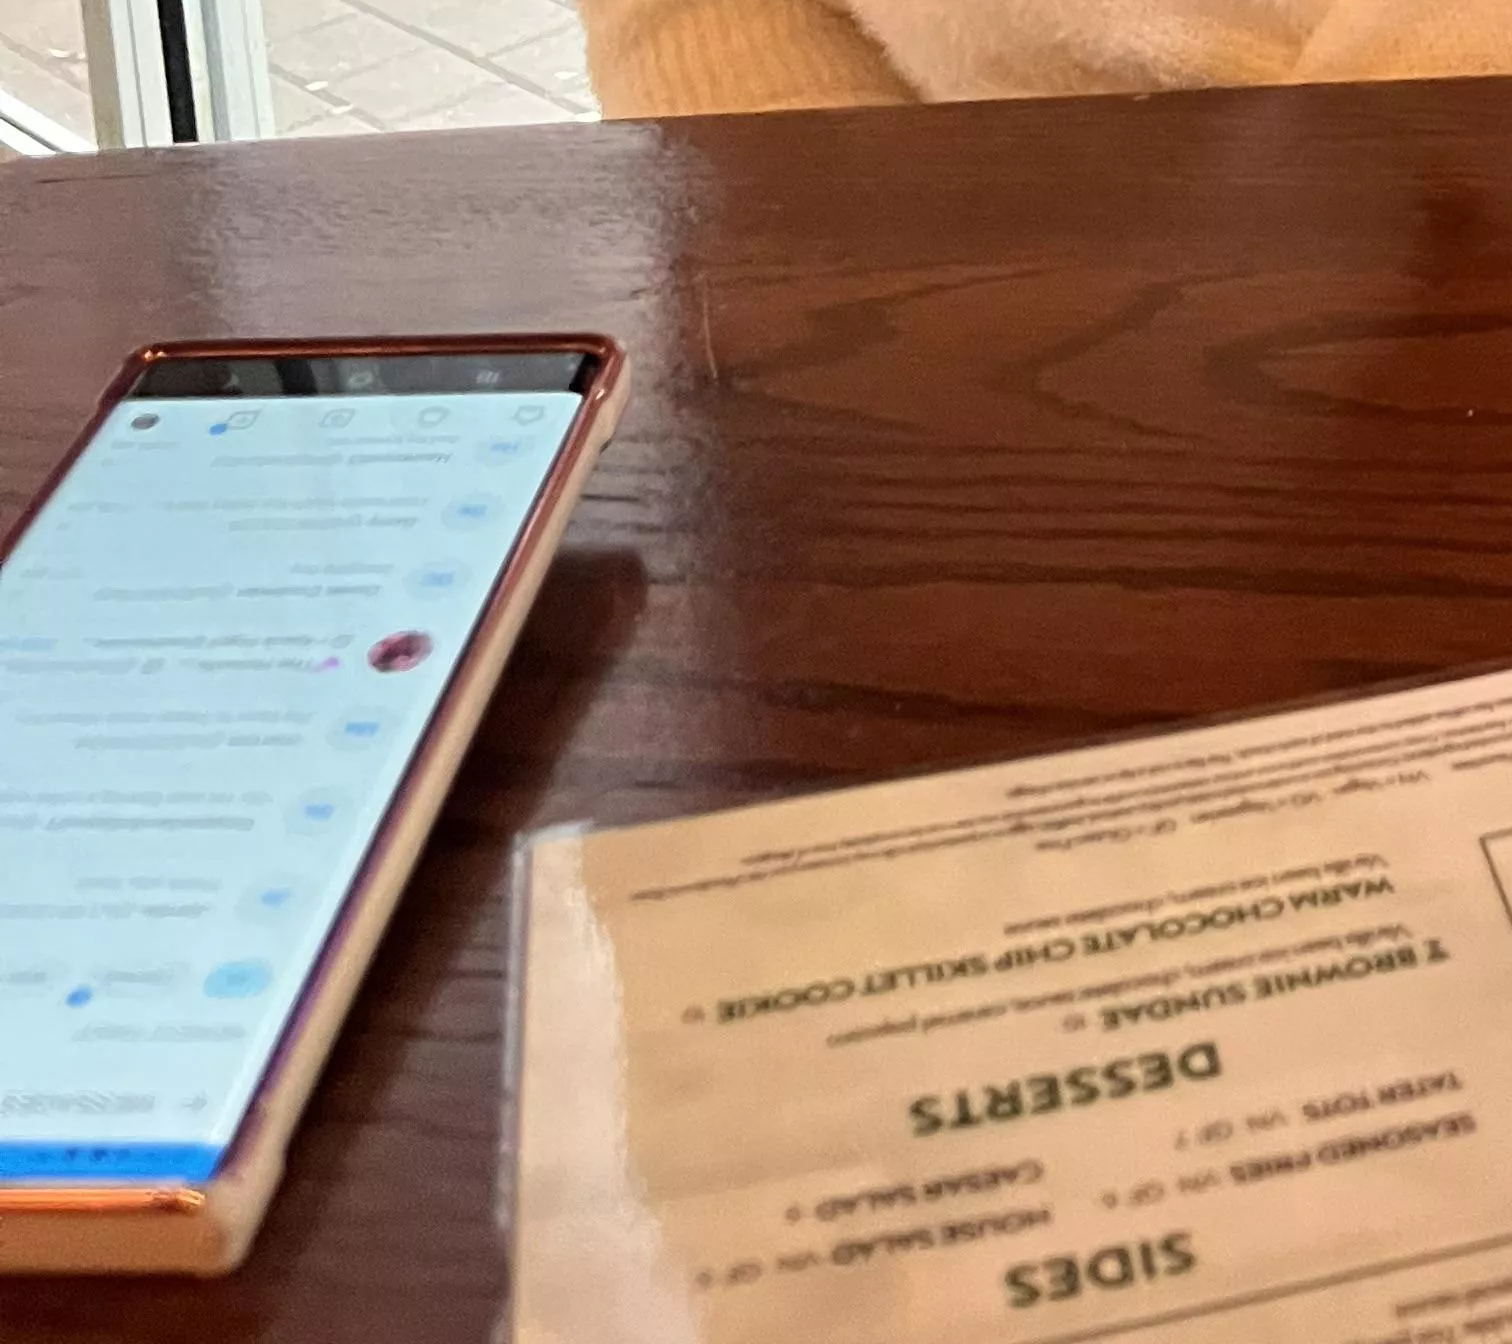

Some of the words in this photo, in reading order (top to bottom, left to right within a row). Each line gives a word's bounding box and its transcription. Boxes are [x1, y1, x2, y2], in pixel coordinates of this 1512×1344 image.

[1287, 876, 1394, 911] WARM
[1081, 896, 1285, 956] CHOCOLATE
[859, 953, 991, 997] SKILLET
[991, 937, 1077, 973] CHIP
[1252, 945, 1418, 999] BROWNIE
[716, 977, 857, 1024] COOKIE
[1099, 981, 1247, 1031] SUNDAE
[909, 1041, 1221, 1136] DESSERTS
[1300, 1090, 1375, 1123] TOTS
[1375, 1070, 1463, 1106] TATER
[813, 1182, 920, 1222] SALAD
[920, 1159, 1044, 1202] CAESAR
[829, 1225, 937, 1266] SALAD
[937, 1207, 1052, 1246] HOUSE
[1004, 1232, 1196, 1308] SIDES
